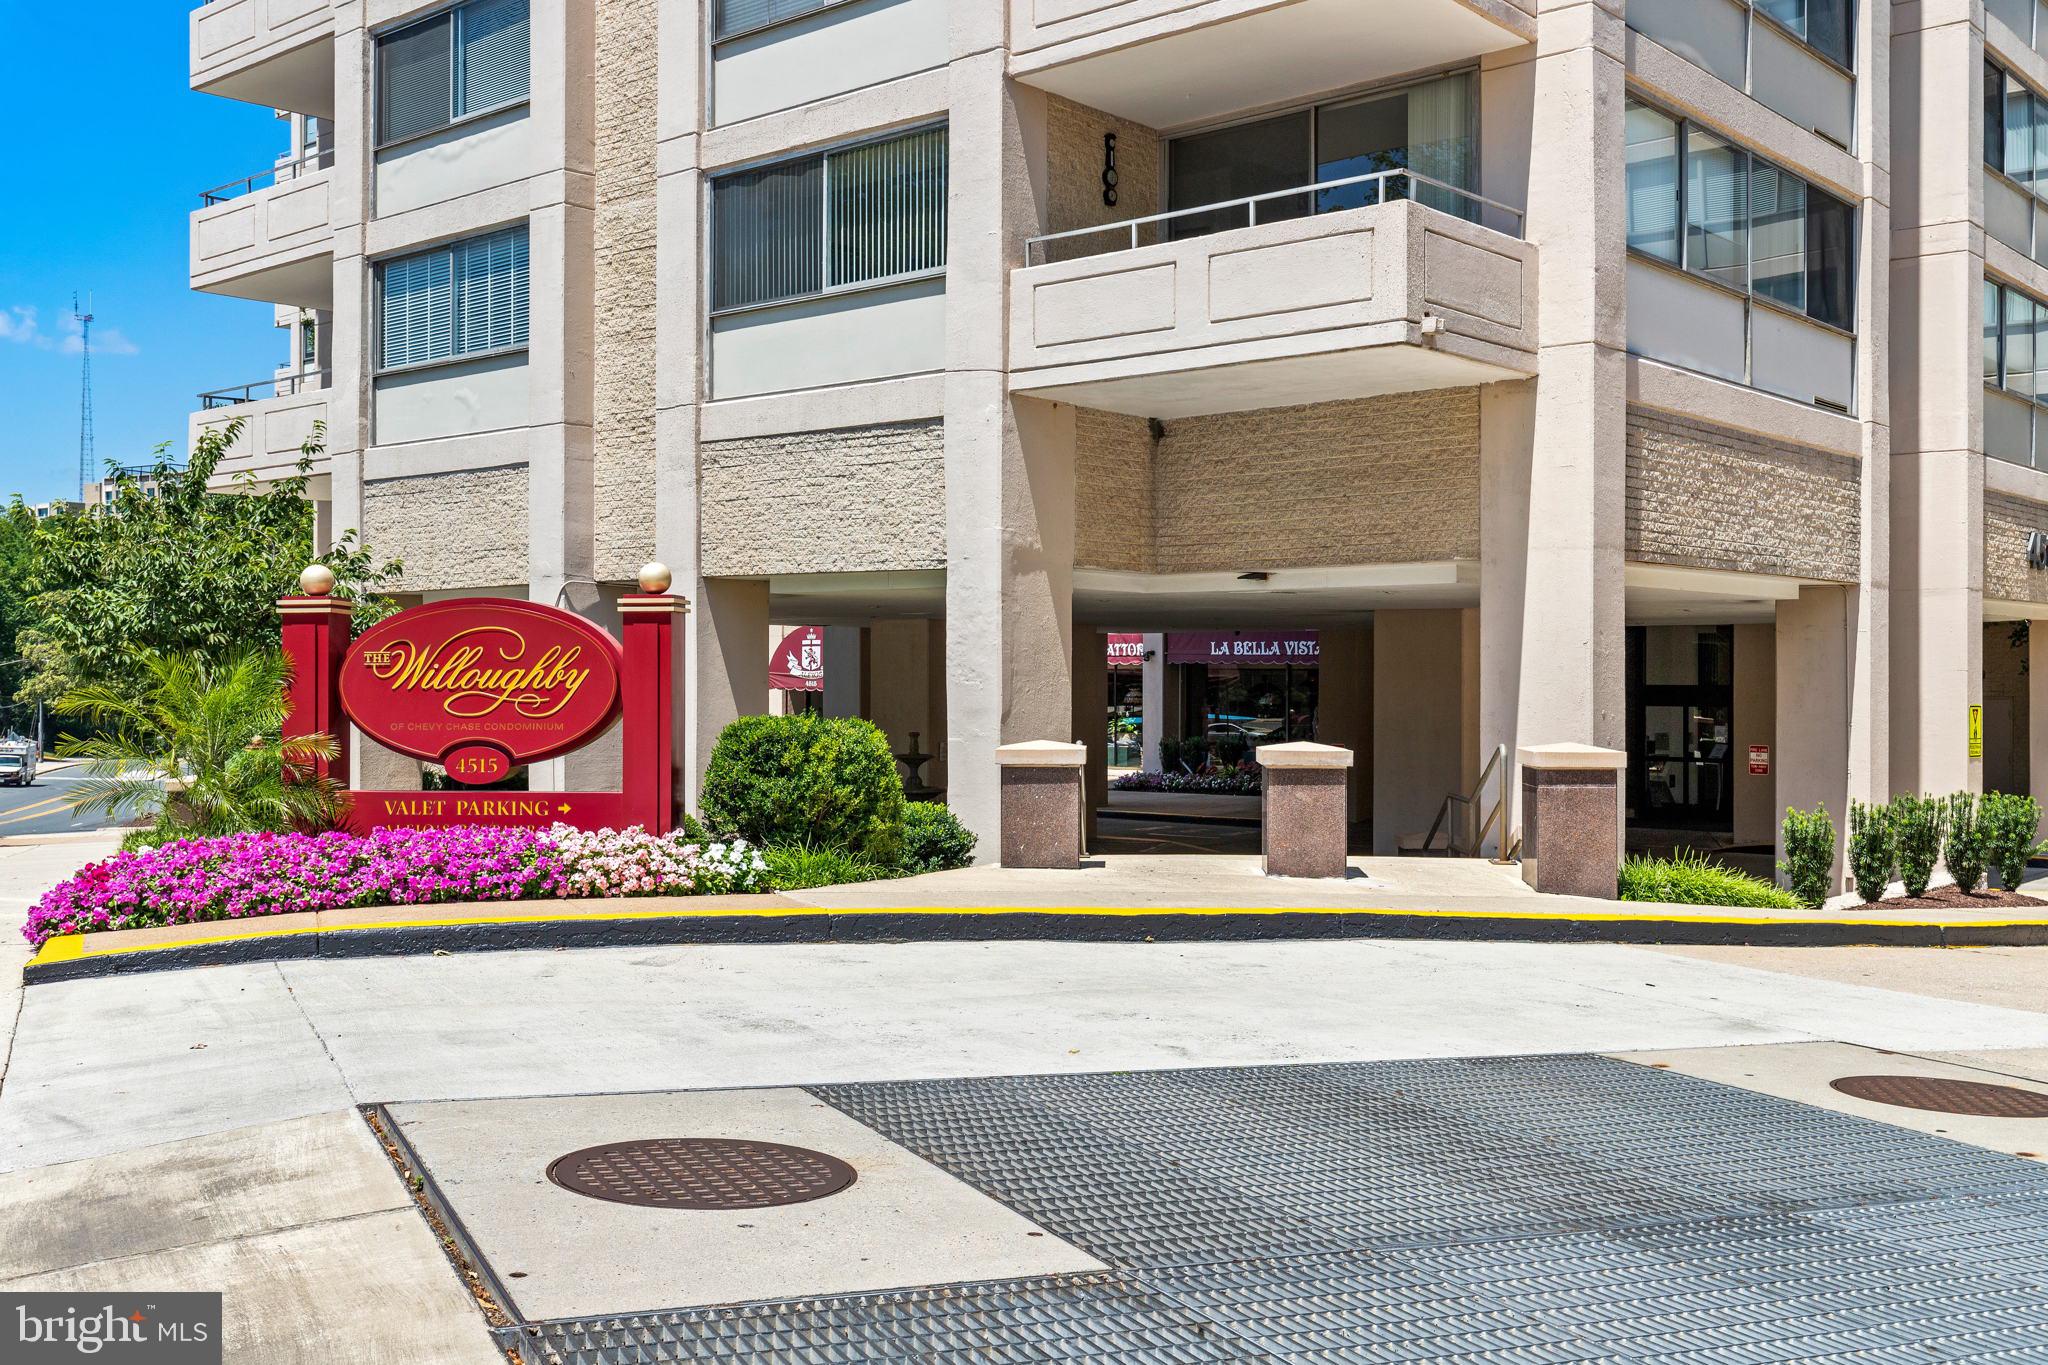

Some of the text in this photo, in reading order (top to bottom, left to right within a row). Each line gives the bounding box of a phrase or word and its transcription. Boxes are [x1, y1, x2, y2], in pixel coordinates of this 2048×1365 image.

[1210, 641, 1230, 655] LA
[1234, 641, 1281, 655] BELLA
[364, 626, 590, 718] THE Willoughby
[390, 722, 564, 731] OF CHEVY CHASE CONDOMINIUM
[456, 758, 498, 773] 4515
[384, 800, 549, 816] VALET PARKING
